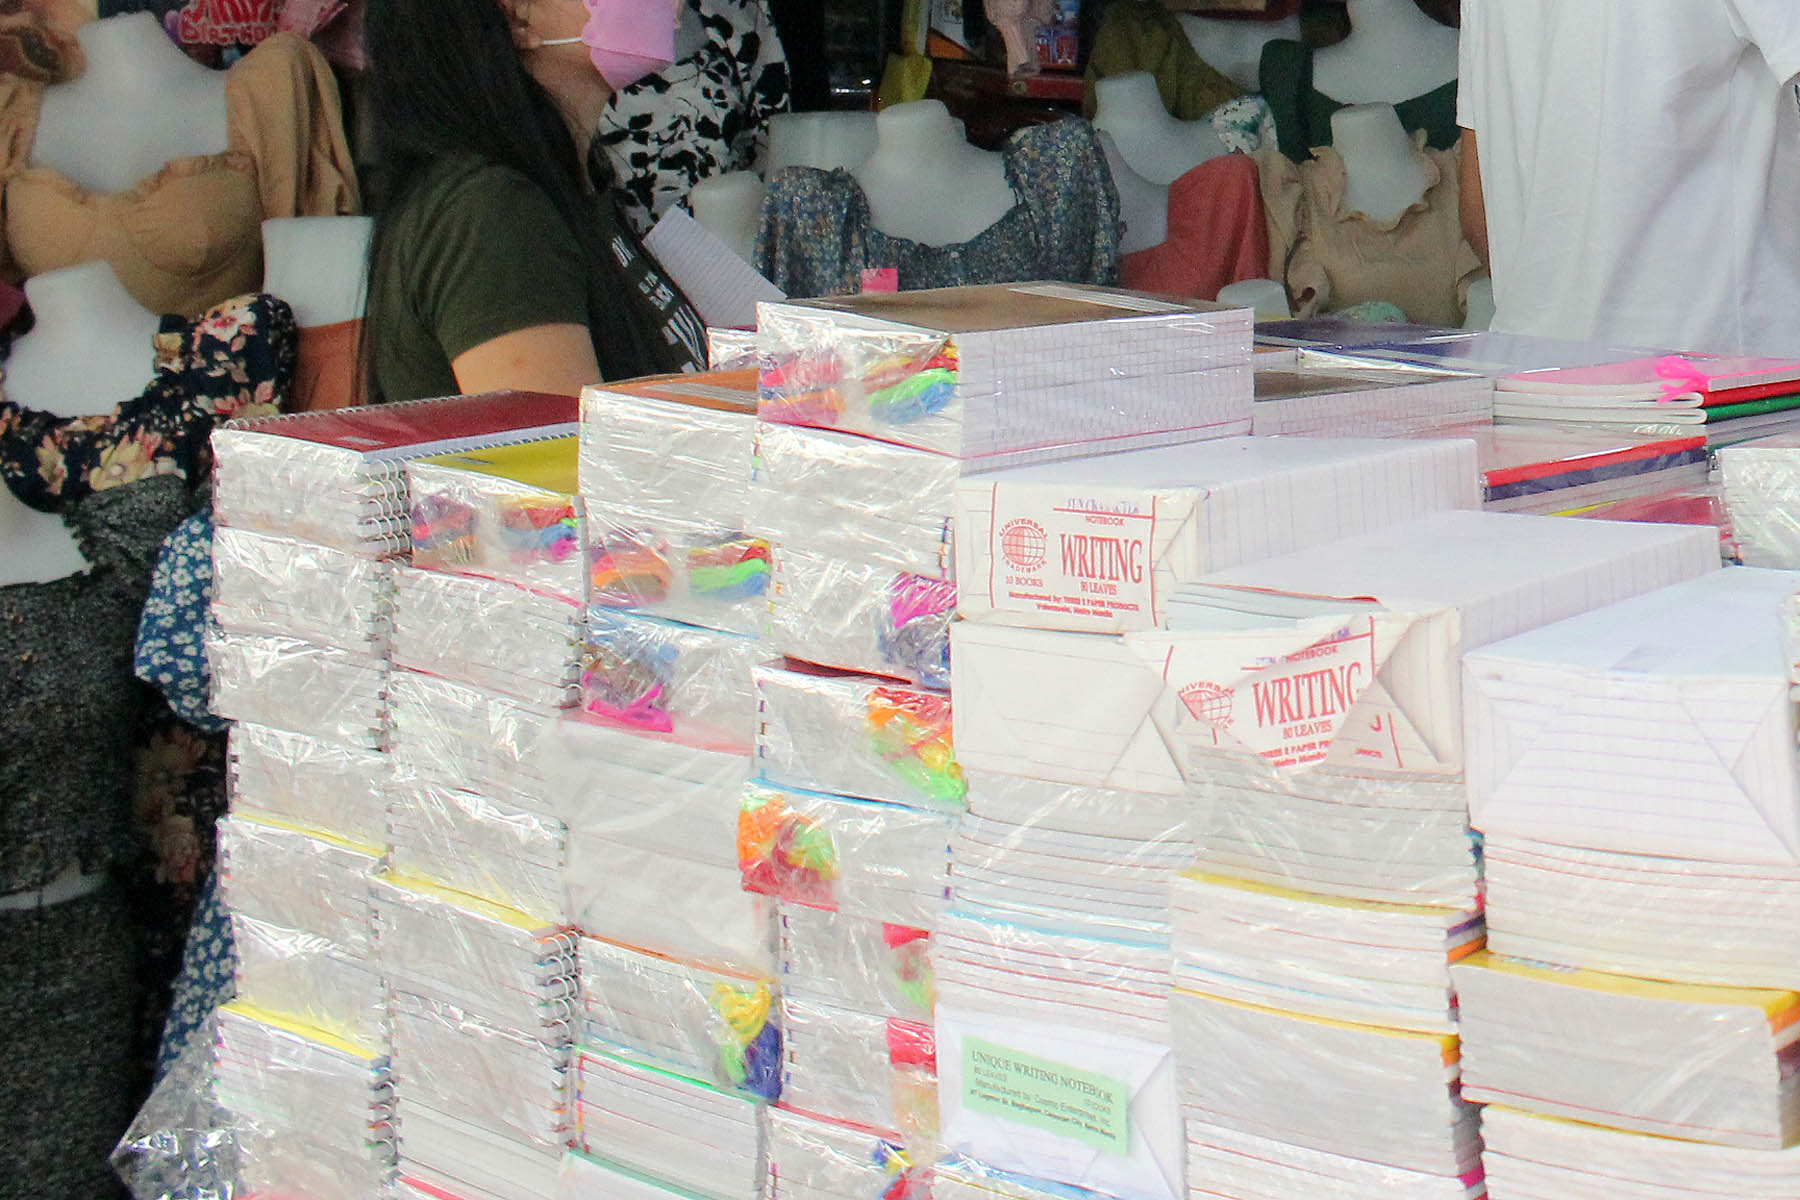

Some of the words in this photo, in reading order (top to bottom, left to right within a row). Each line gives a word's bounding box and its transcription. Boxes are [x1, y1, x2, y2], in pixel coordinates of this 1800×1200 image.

[998, 517, 1049, 539] UNIVERSAL
[1085, 514, 1126, 527] NOTEBOOK
[1059, 533, 1144, 584] WRITING
[1090, 582, 1119, 596] LEAVES
[1285, 644, 1338, 664] NOTEBOOK
[1294, 720, 1333, 738] LEAVES
[1012, 1062, 1059, 1086] WRITING
